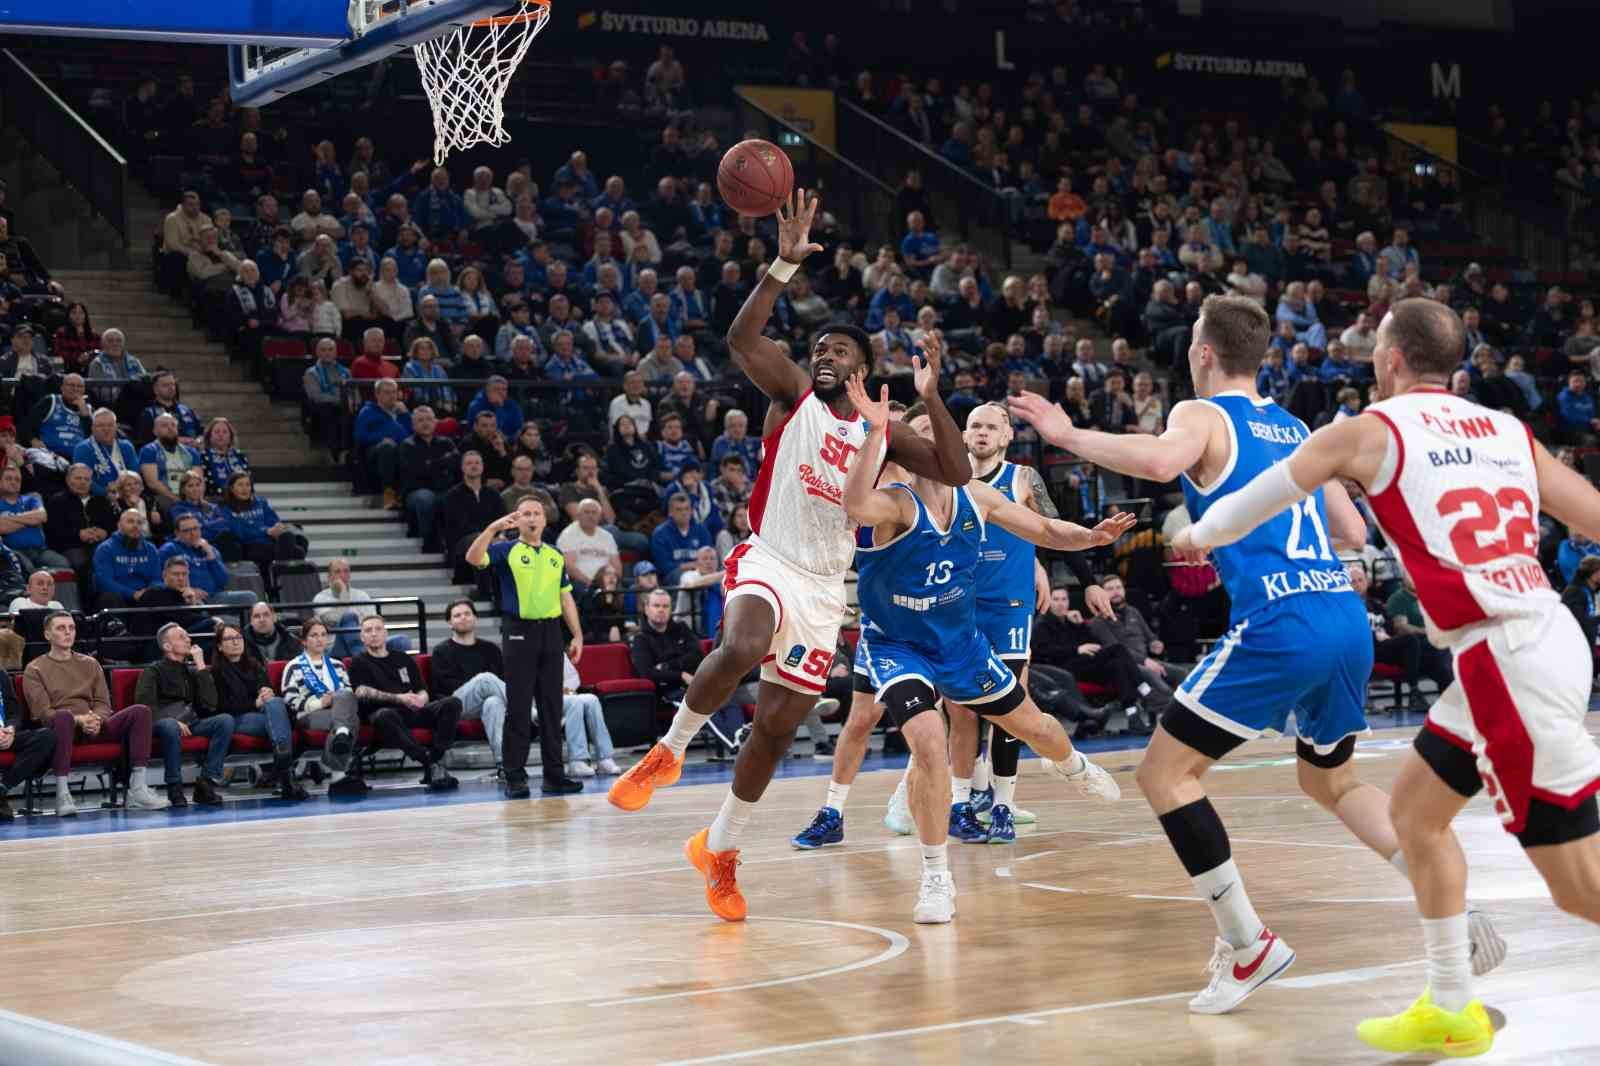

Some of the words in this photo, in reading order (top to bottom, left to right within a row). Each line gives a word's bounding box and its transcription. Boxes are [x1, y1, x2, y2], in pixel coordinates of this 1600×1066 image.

[601, 10, 699, 36] ŠVYTURIO
[702, 20, 769, 41] ARENA
[996, 30, 1016, 69] L
[1431, 61, 1461, 98] M
[1428, 447, 1473, 467] BAU
[1436, 487, 1537, 566] 22
[1008, 627, 1024, 650] 11
